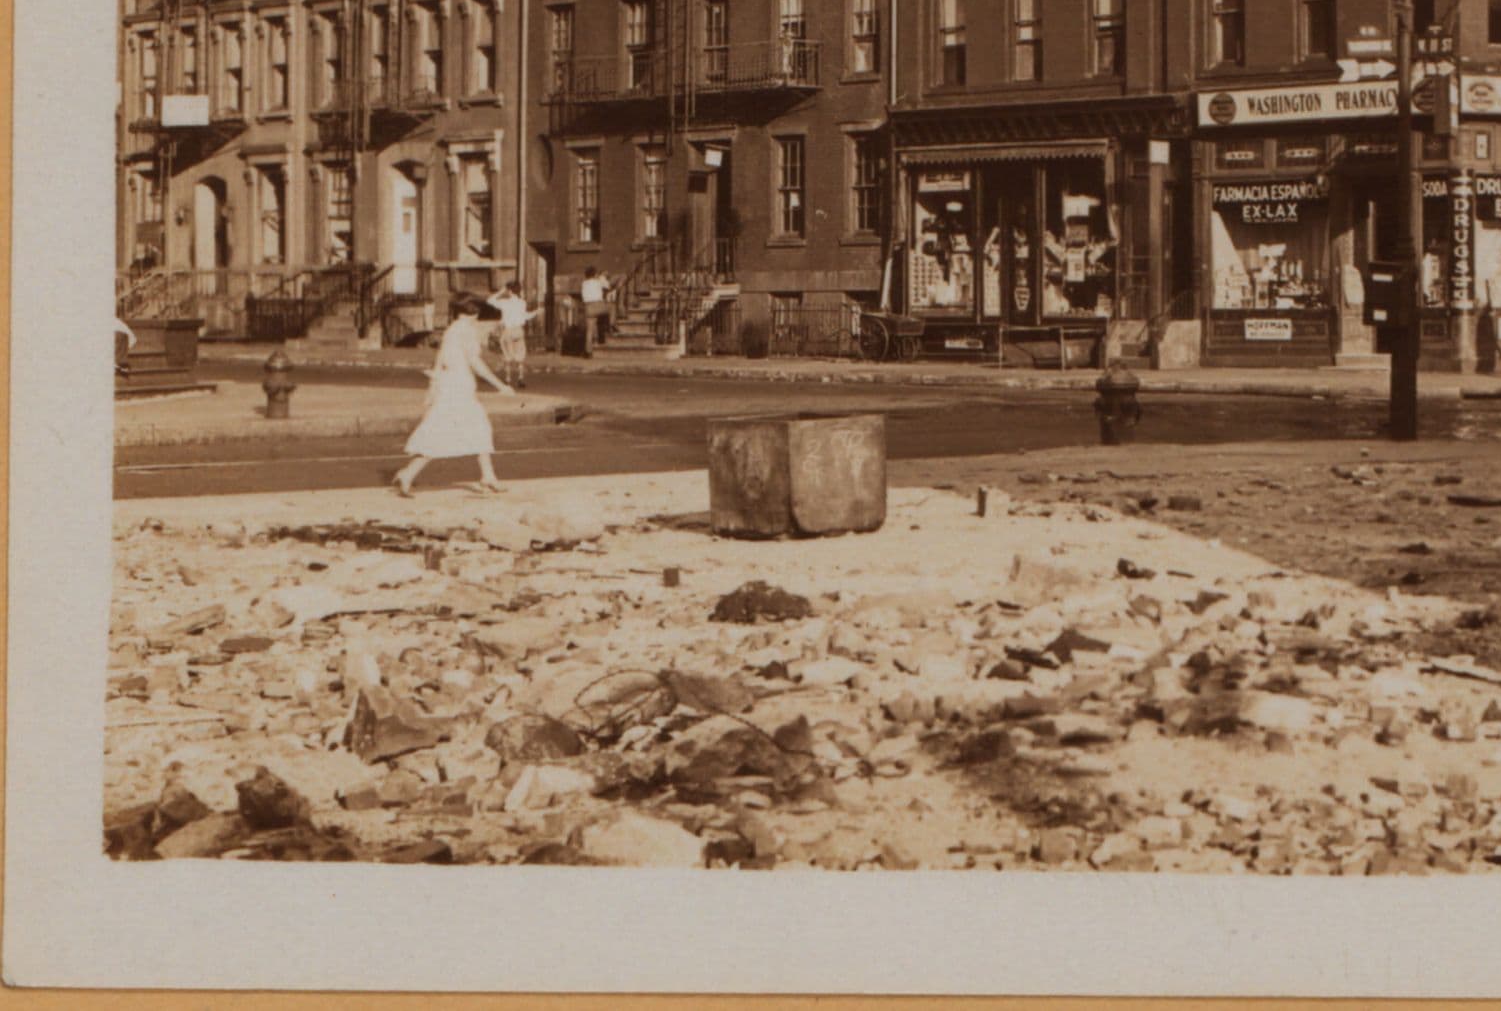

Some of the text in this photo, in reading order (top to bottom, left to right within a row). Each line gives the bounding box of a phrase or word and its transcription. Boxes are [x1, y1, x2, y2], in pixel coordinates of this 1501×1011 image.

[1247, 92, 1321, 116] WASHINGTON
[1213, 185, 1269, 203] FARMACIA
[1423, 181, 1448, 197] SODA
